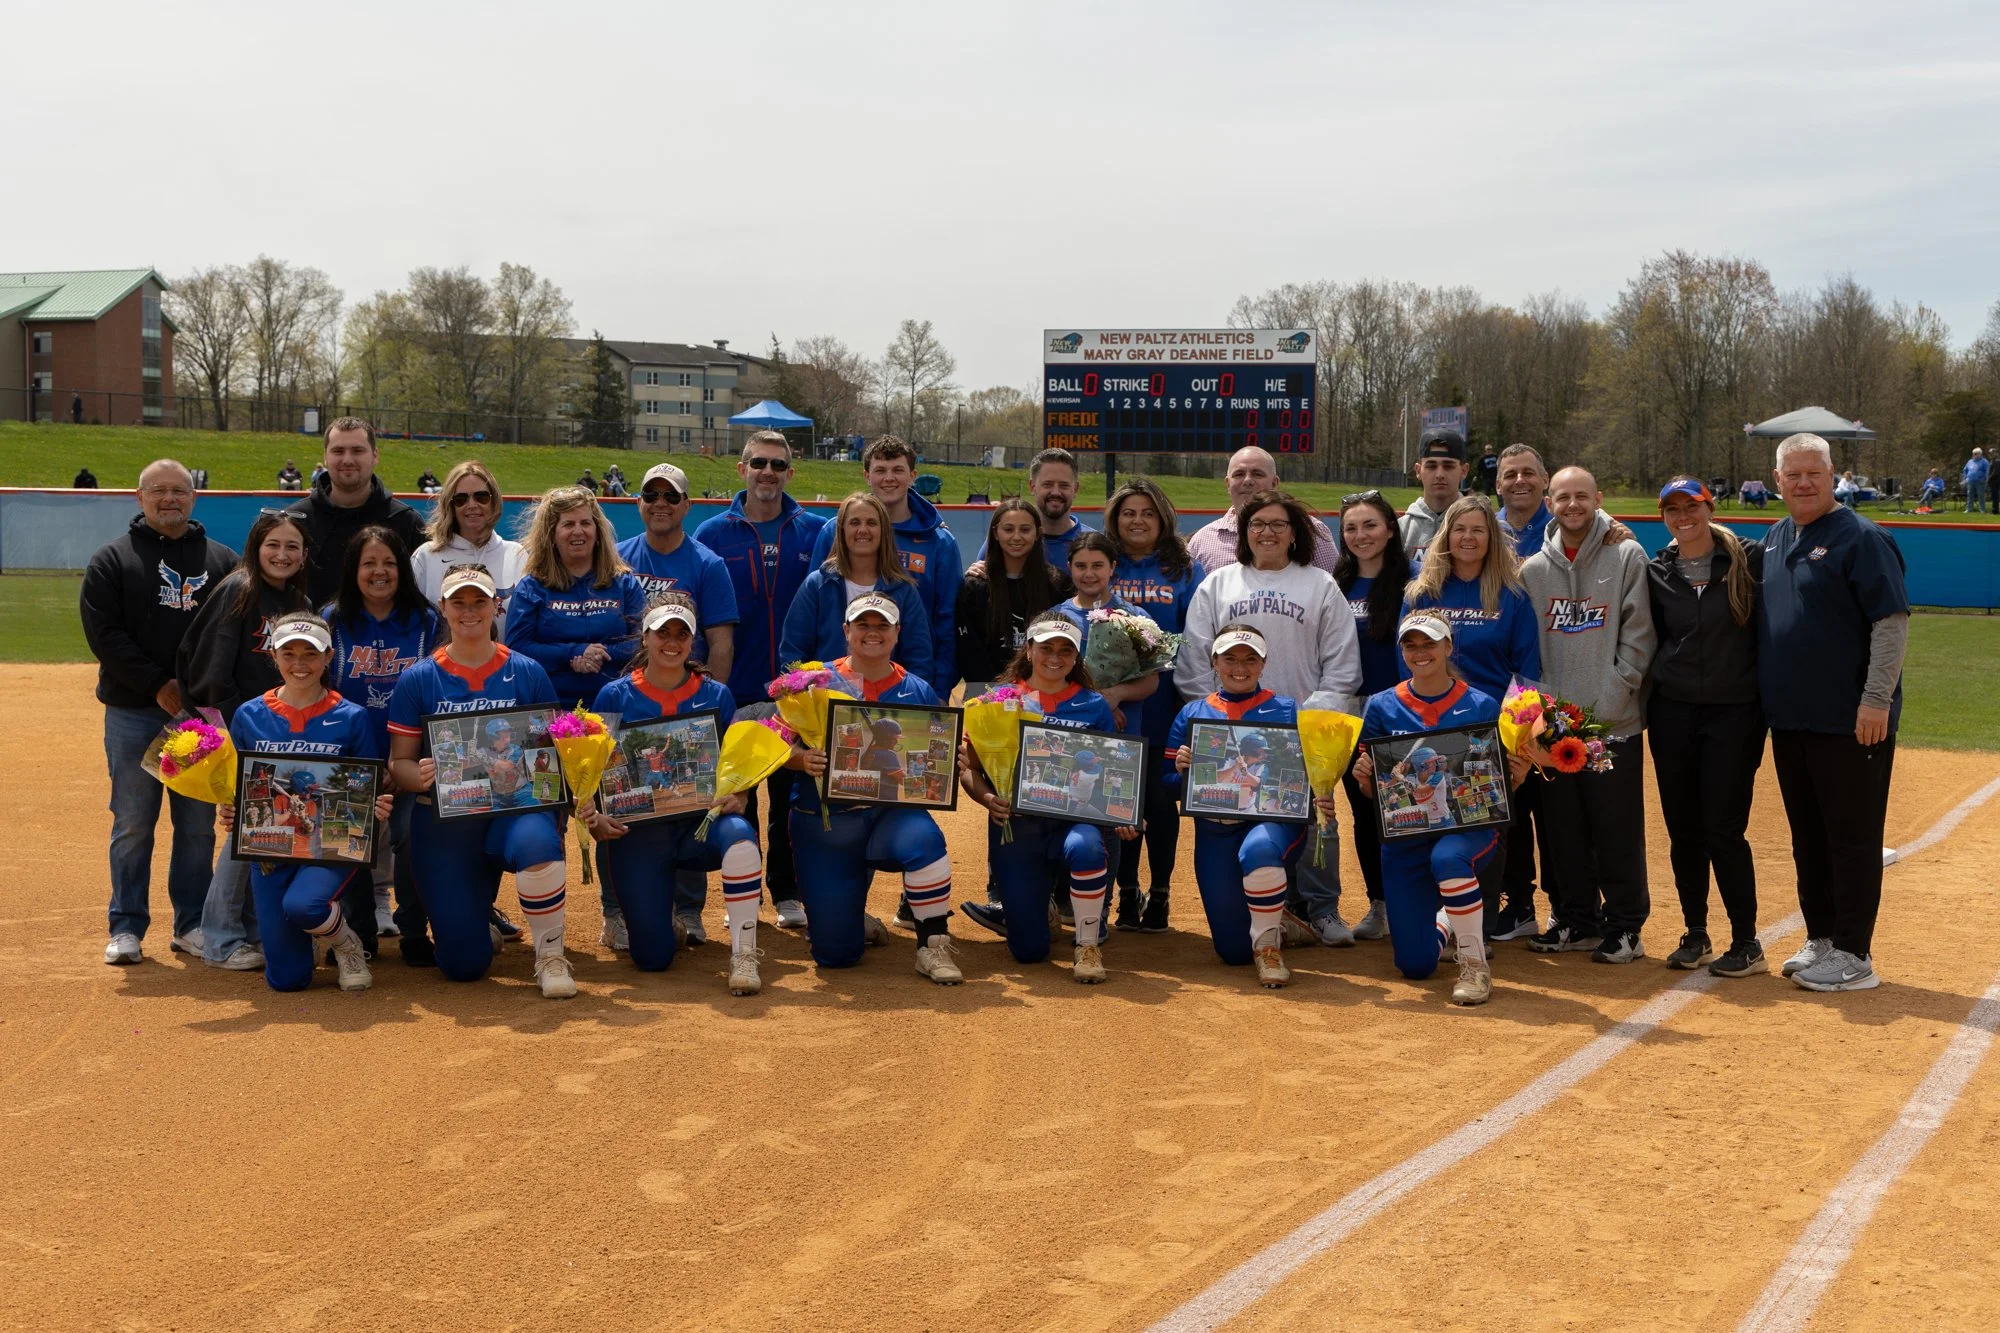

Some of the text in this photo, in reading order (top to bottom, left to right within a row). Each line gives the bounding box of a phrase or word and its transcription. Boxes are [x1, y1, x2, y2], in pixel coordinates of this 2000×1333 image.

[1100, 333, 1254, 344] NEW PALTZ ATHLETICS
[1084, 349, 1273, 360] MARY GRAY DEANNE FIELD
[1049, 373, 1286, 395] BALL 0 STRIKE 0 OUT 0 H/E
[1108, 398, 1309, 409] 1 2 3 4 5 6 7 8 RUNS HITS E
[1247, 410, 1258, 428] 0
[1280, 410, 1292, 428] 0
[1299, 410, 1310, 428] 0
[1280, 433, 1292, 451] 0
[1298, 433, 1310, 451] 0
[1250, 590, 1286, 599] SUNY
[552, 600, 618, 611] NEW PALTZ
[865, 597, 884, 607] NP
[1229, 597, 1305, 625] NEW PALTZ
[291, 623, 312, 632] NP
[958, 625, 969, 636] 14
[347, 645, 400, 662] NEW
[436, 701, 475, 715] NEW
[255, 739, 342, 756] NEW PALTZ
